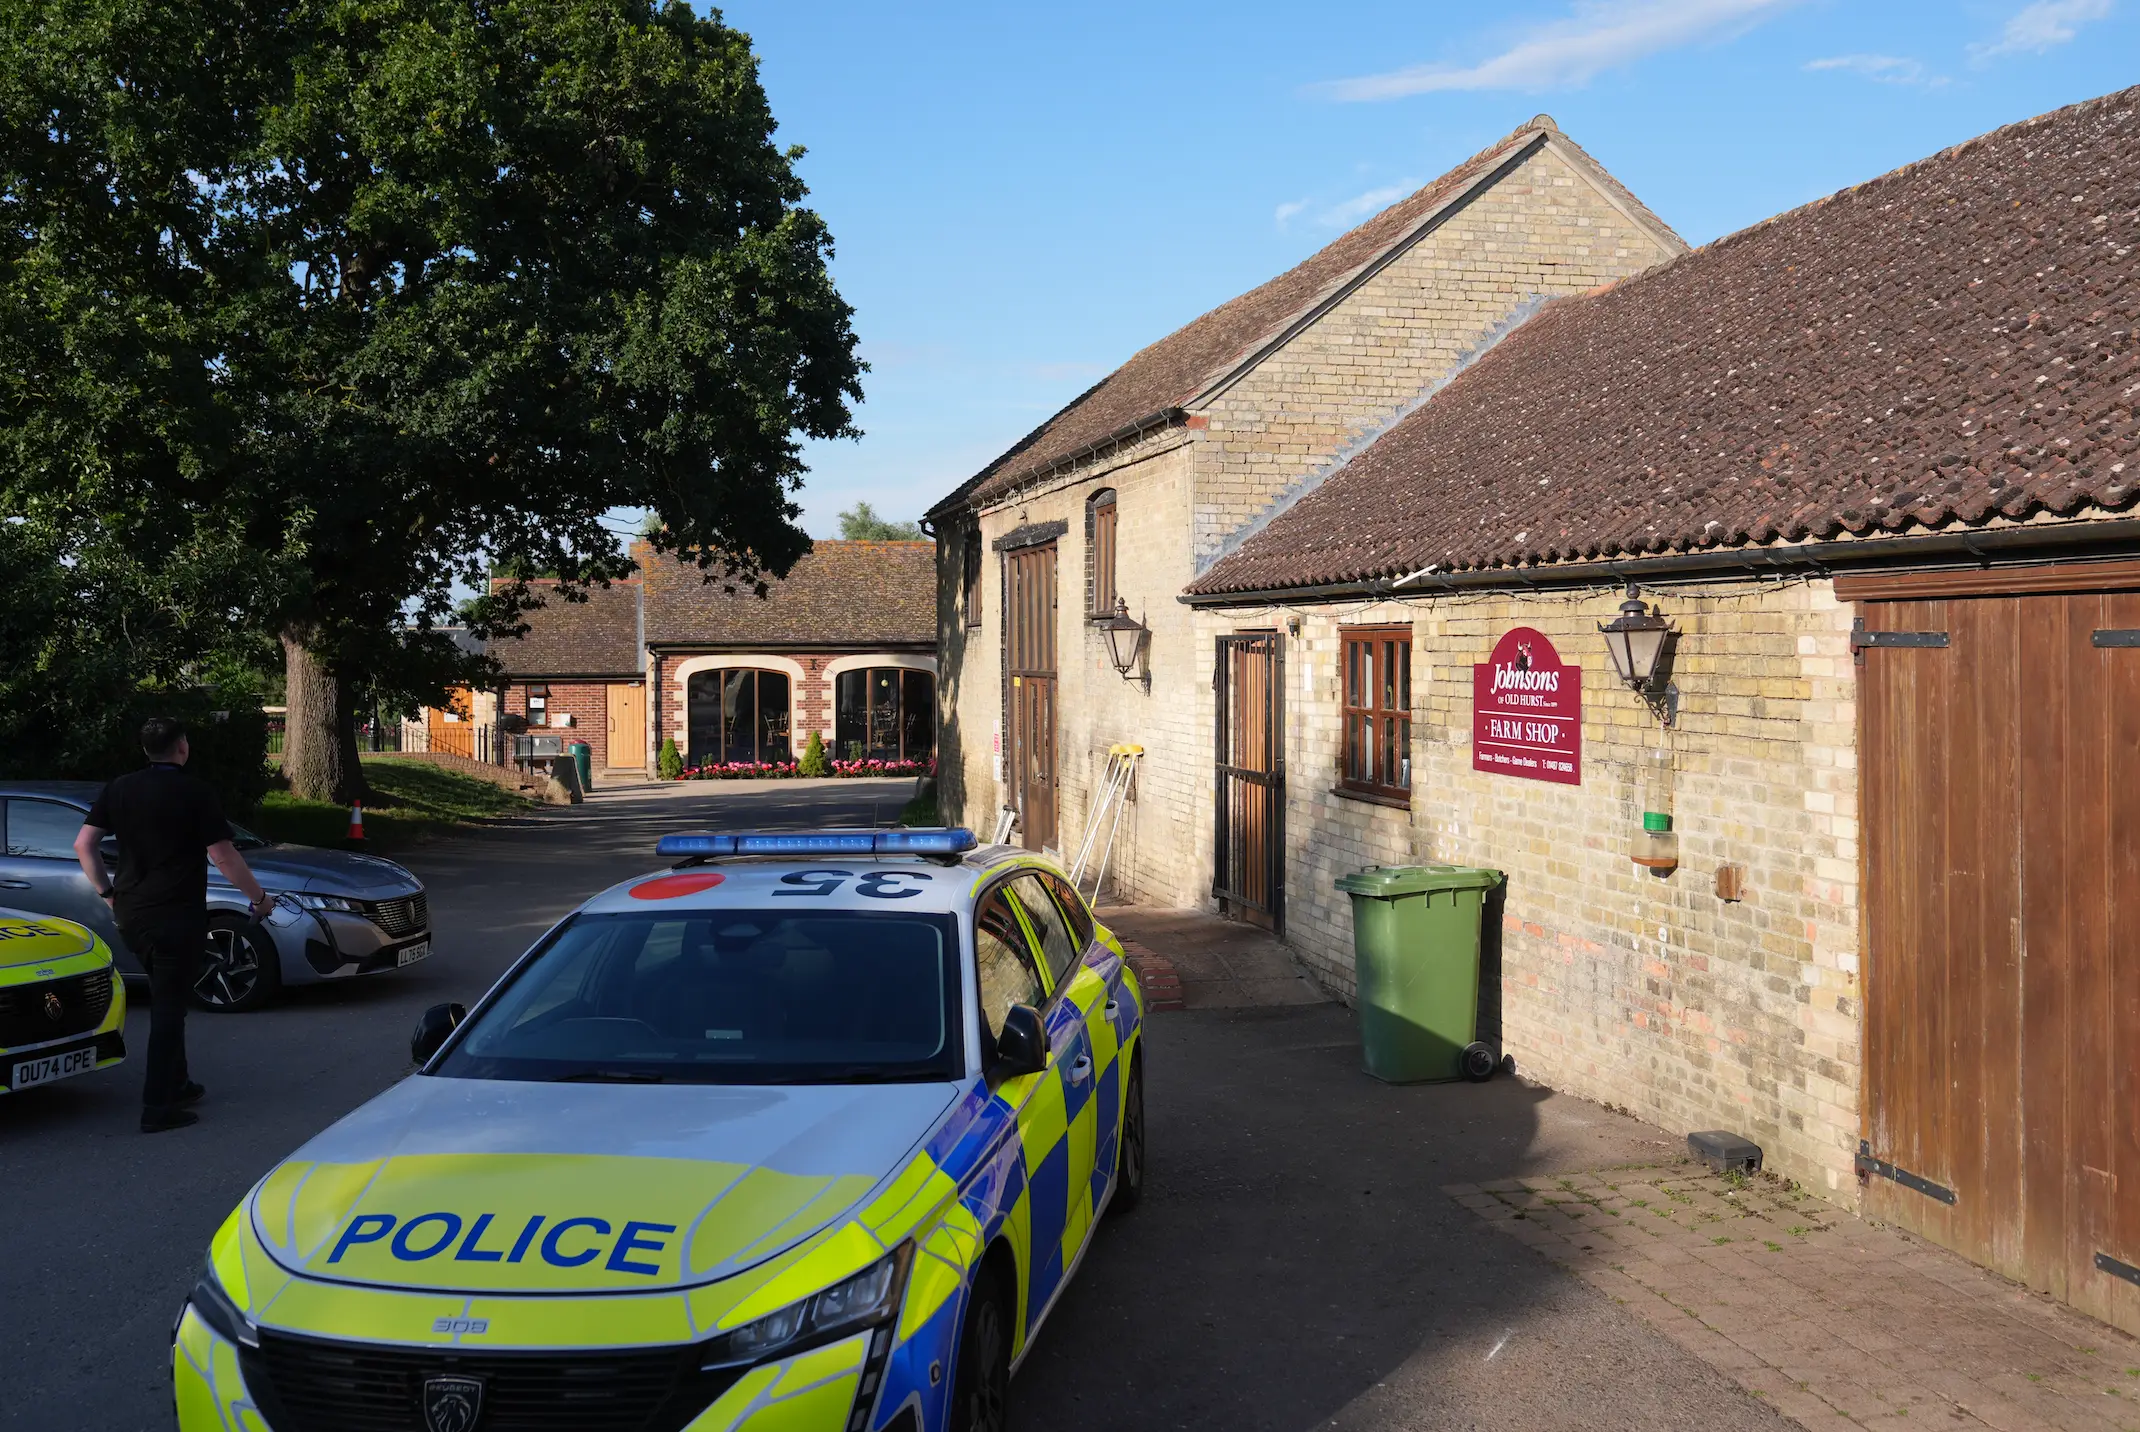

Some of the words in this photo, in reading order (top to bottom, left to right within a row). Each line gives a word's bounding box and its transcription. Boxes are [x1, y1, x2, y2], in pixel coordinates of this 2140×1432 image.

[1490, 661, 1559, 694] Johnsons
[1505, 694, 1519, 705] OLD
[1520, 695, 1544, 707] HURST
[1490, 719, 1522, 740] FARM
[1526, 722, 1559, 743] SHOP
[20, 1062, 60, 1084] OU74
[64, 1050, 91, 1073] CPE
[326, 1212, 677, 1276] POLICE
[433, 1318, 489, 1334] 308
